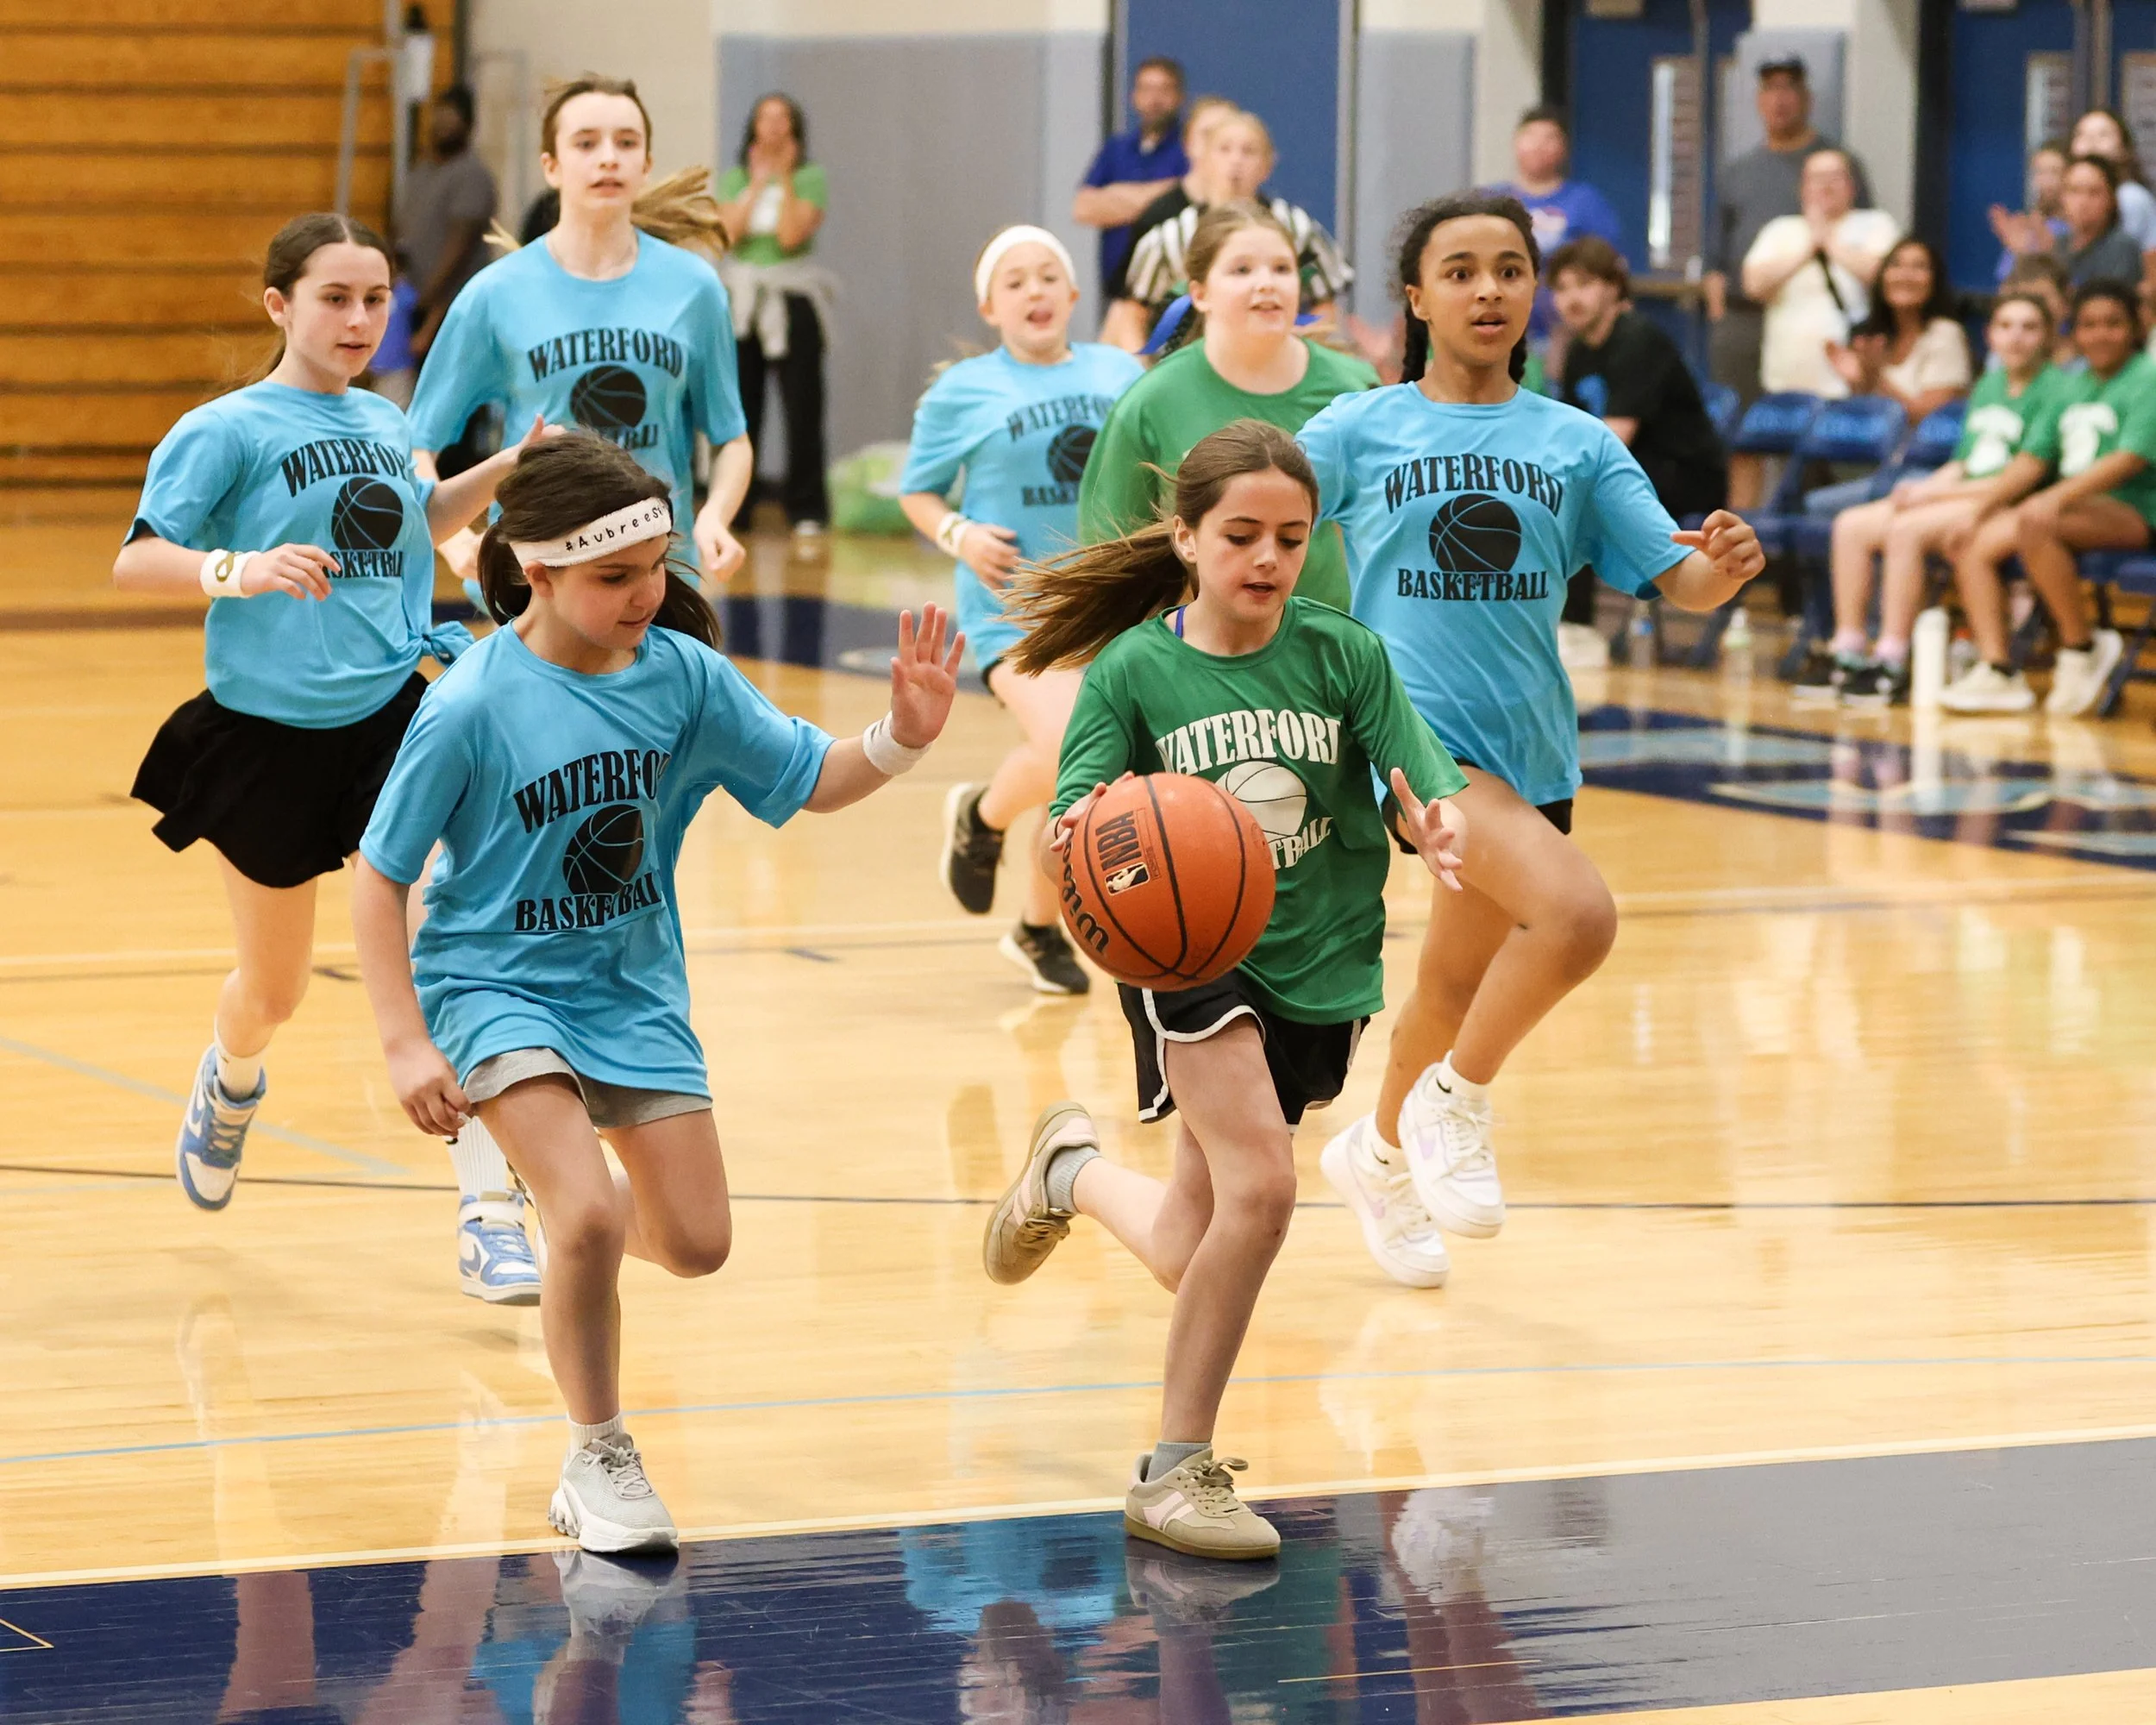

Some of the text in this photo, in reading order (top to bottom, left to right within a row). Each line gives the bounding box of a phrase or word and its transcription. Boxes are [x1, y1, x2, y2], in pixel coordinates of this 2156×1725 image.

[528, 327, 683, 383] WATERFORD
[1385, 453, 1563, 514] WATERFORD
[1397, 568, 1549, 601] BASKETBALL
[513, 750, 671, 834] WATERFO
[1094, 810, 1142, 871] NBA
